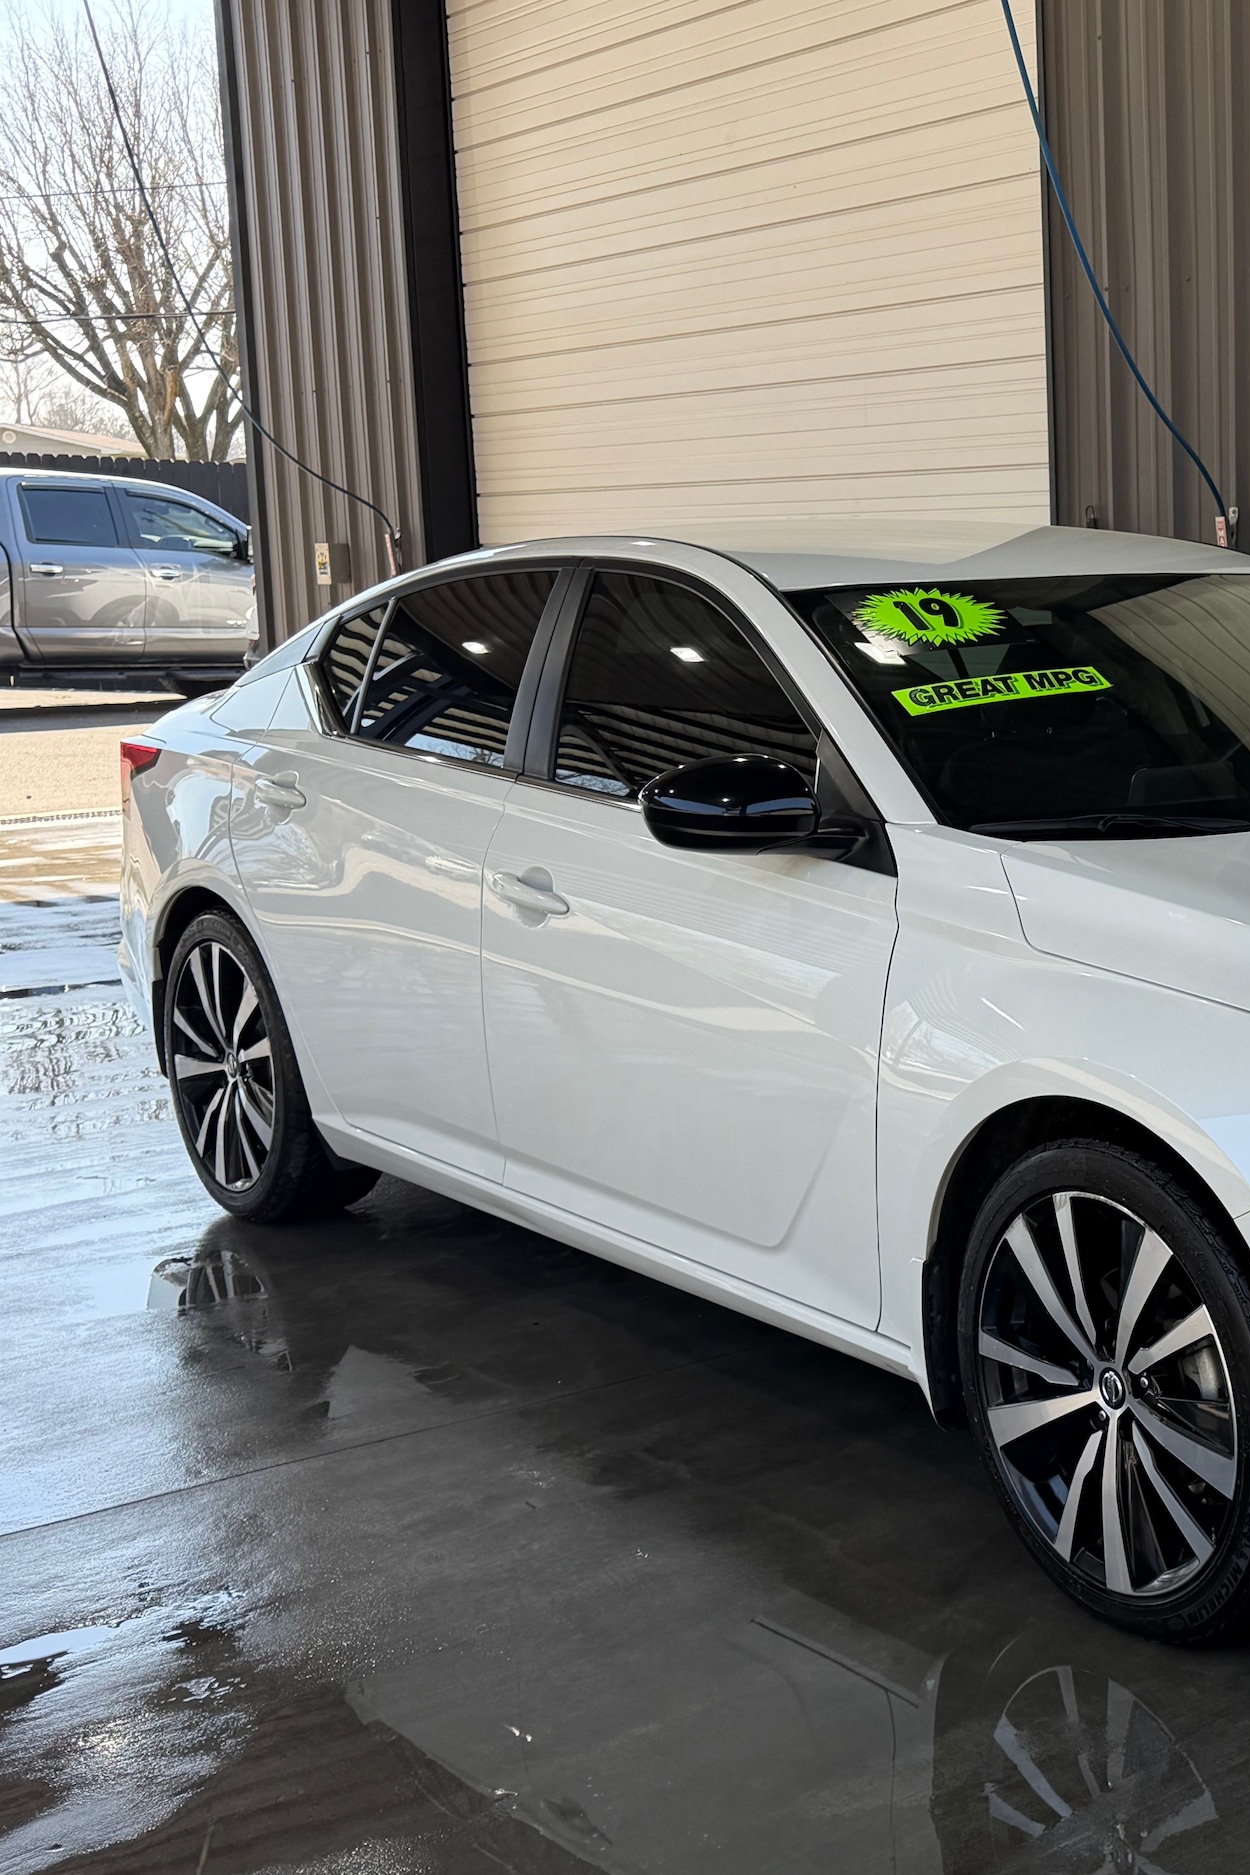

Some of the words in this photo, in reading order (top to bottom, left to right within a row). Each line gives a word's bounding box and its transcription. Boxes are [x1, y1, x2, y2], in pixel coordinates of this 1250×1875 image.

[892, 598, 964, 632] 19
[908, 675, 1017, 708] GREAT
[1023, 668, 1102, 692] MPG
[1187, 1561, 1244, 1626] MICHELIN
